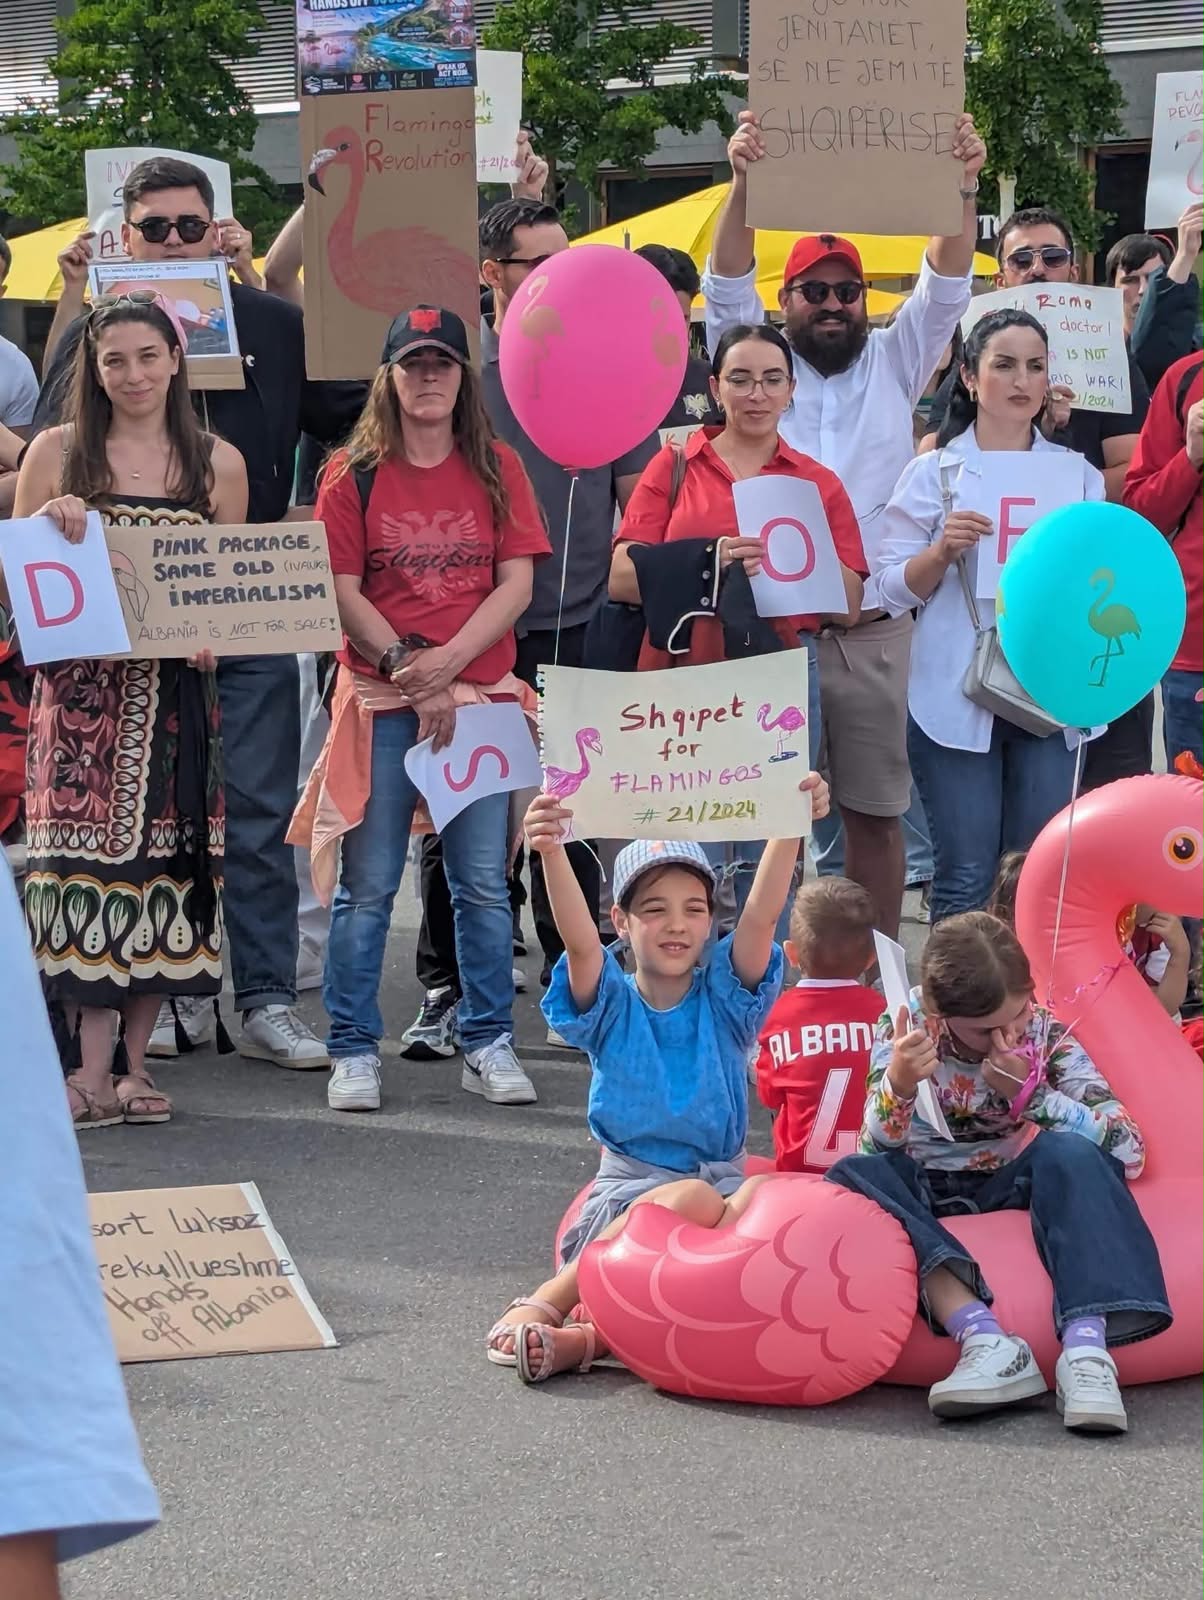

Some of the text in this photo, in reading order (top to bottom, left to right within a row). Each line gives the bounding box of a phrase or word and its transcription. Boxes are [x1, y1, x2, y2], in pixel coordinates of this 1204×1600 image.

[759, 59, 791, 82] SE
[805, 58, 845, 84] NE
[365, 104, 473, 147] Flamingo
[366, 139, 473, 173] Revolution
[1067, 349, 1079, 360] IS
[1084, 348, 1109, 361] NOT
[759, 517, 817, 582] O
[997, 497, 1036, 564] F
[154, 561, 216, 582] SAME
[233, 560, 275, 575] OLD
[24, 561, 85, 629] D
[230, 621, 260, 639] NOT
[264, 621, 289, 632] FOR
[294, 617, 336, 631] SALE!
[619, 692, 747, 737] Shqipet
[443, 744, 510, 793] S
[658, 738, 702, 762] for
[610, 763, 763, 794] FLAMINGOS
[803, 1067, 859, 1168] 4
[98, 1250, 296, 1280] rekullueshme
[104, 1278, 209, 1322] Hands
[142, 1284, 294, 1350] off Albania
